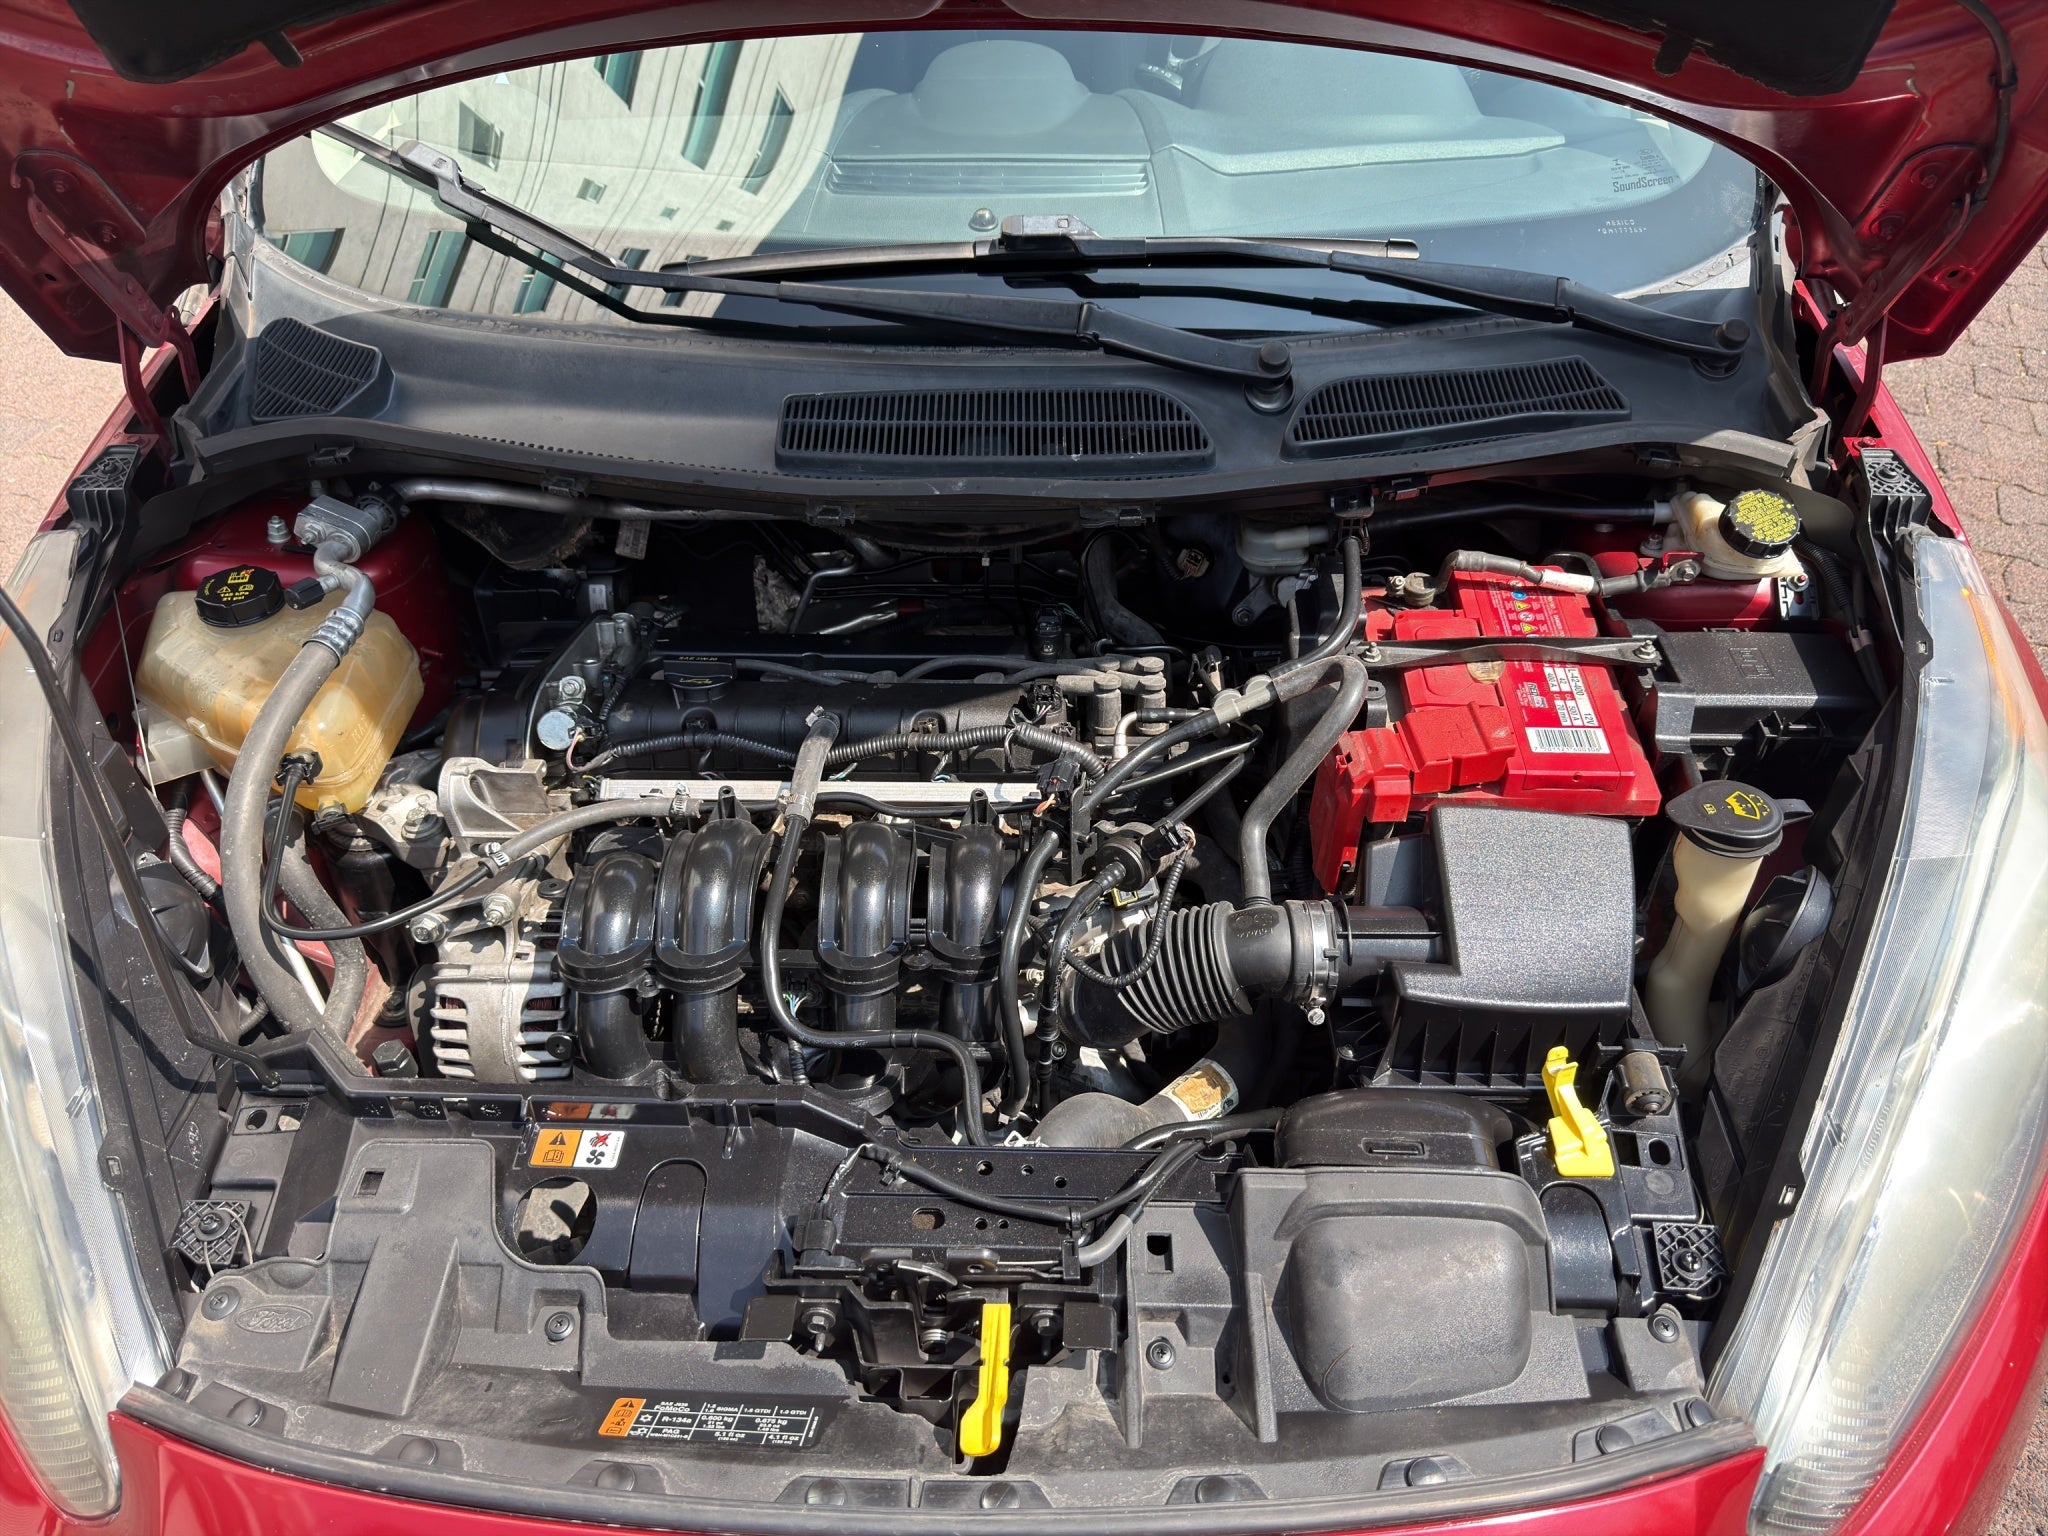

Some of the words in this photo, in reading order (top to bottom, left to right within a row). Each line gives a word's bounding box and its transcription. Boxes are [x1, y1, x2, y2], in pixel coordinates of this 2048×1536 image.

[1613, 176, 1674, 192] SoundScreen
[1568, 669, 1584, 696] L-42-400
[1584, 713, 1596, 726] 12V
[249, 1310, 300, 1330] Ford
[654, 1404, 691, 1412] FoMoCo
[661, 1415, 693, 1424] R-134a
